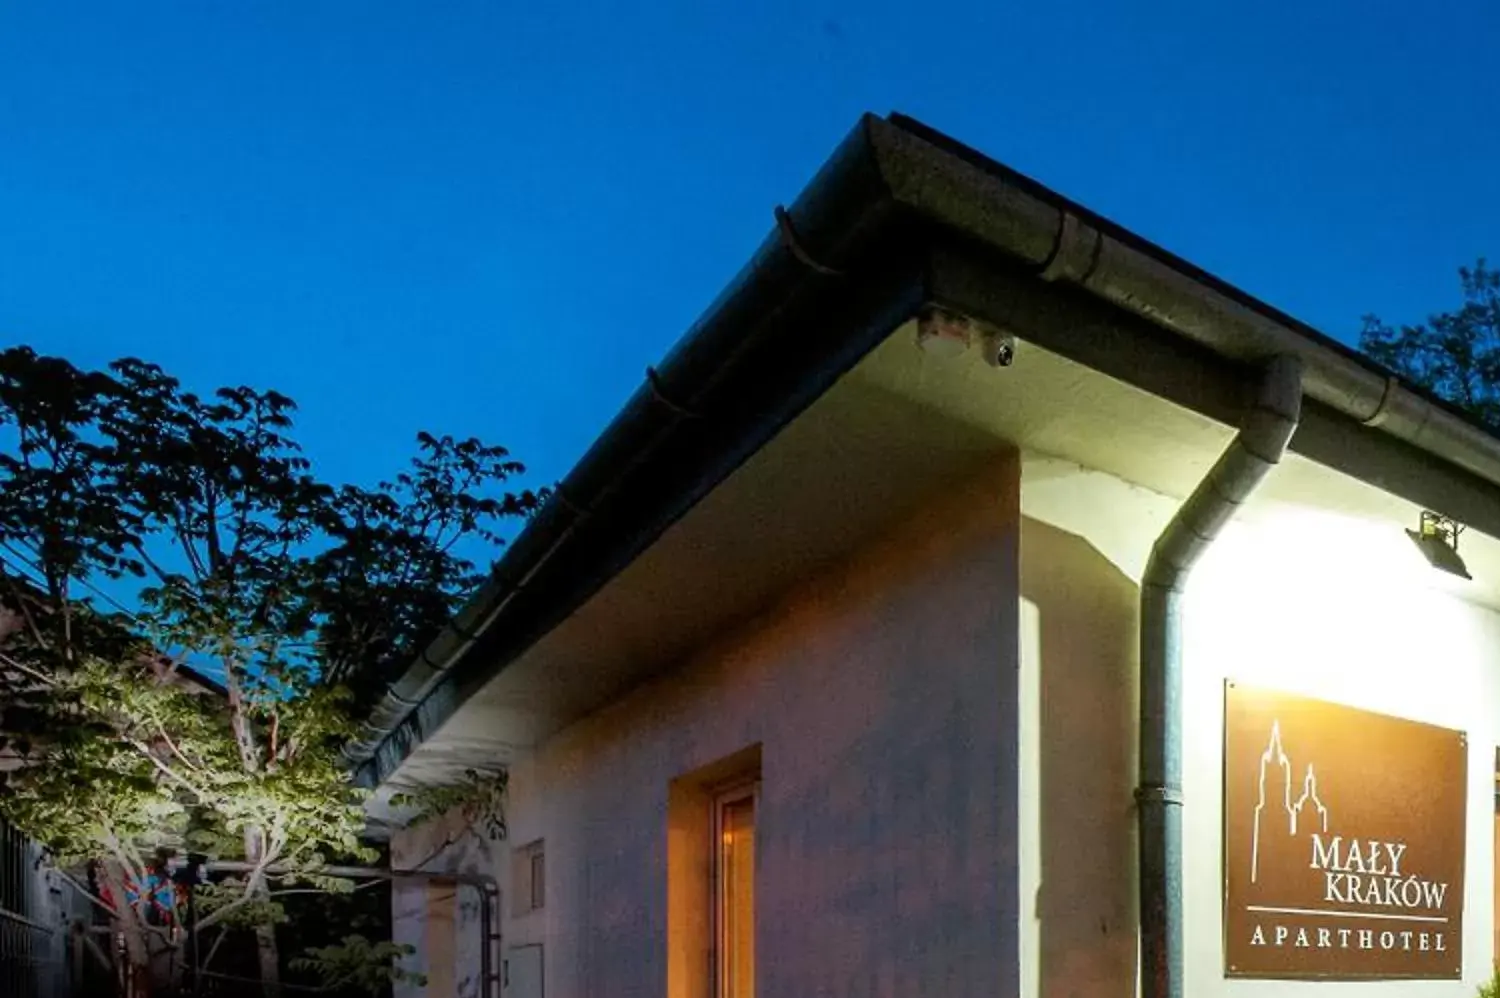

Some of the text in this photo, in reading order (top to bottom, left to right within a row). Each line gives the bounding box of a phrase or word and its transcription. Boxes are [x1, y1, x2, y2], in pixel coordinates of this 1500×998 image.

[1310, 834, 1405, 876] MAŁY
[1325, 873, 1447, 909] KRAKÓW
[1250, 925, 1446, 951] APARTHOTEL
